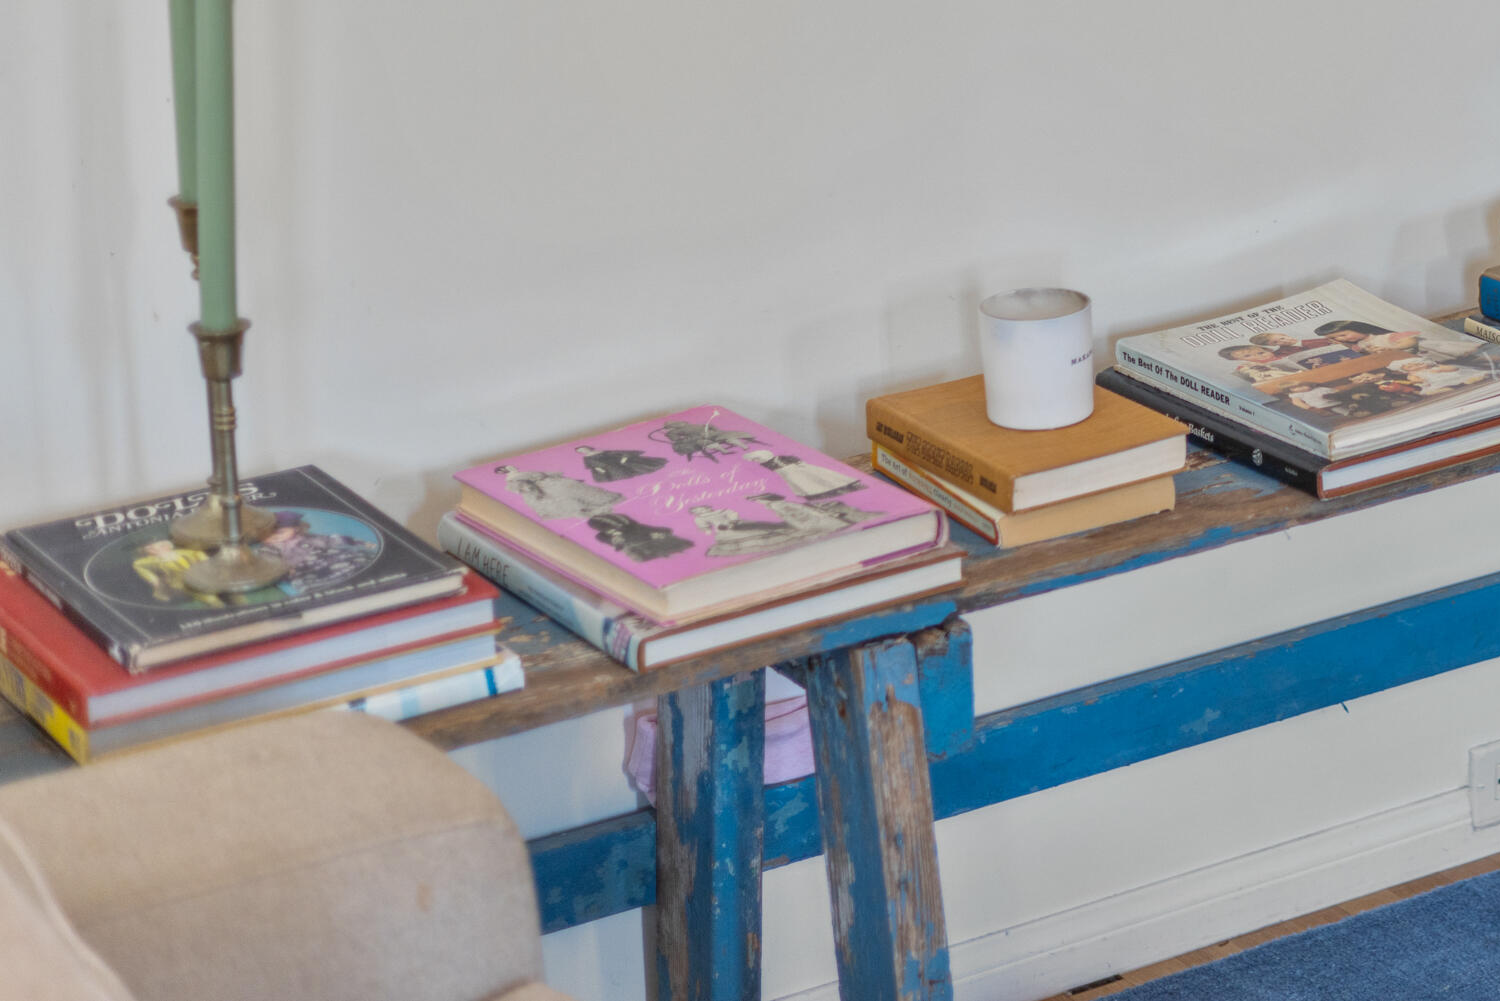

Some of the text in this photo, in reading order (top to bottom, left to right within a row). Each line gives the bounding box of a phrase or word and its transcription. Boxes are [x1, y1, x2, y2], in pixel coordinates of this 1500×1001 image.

[1196, 305, 1286, 332] THE BEST OF THE
[1240, 300, 1333, 334] READER
[1122, 351, 1136, 365] The
[1138, 355, 1153, 371] Best
[1155, 364, 1163, 375] Of
[1165, 369, 1178, 384] The
[1180, 375, 1199, 393] DOLL
[1200, 385, 1231, 407] READER
[1187, 422, 1215, 443] Baskets
[880, 452, 892, 467] The
[719, 463, 740, 484] of
[464, 546, 481, 569] AM
[482, 555, 511, 587] HERE
